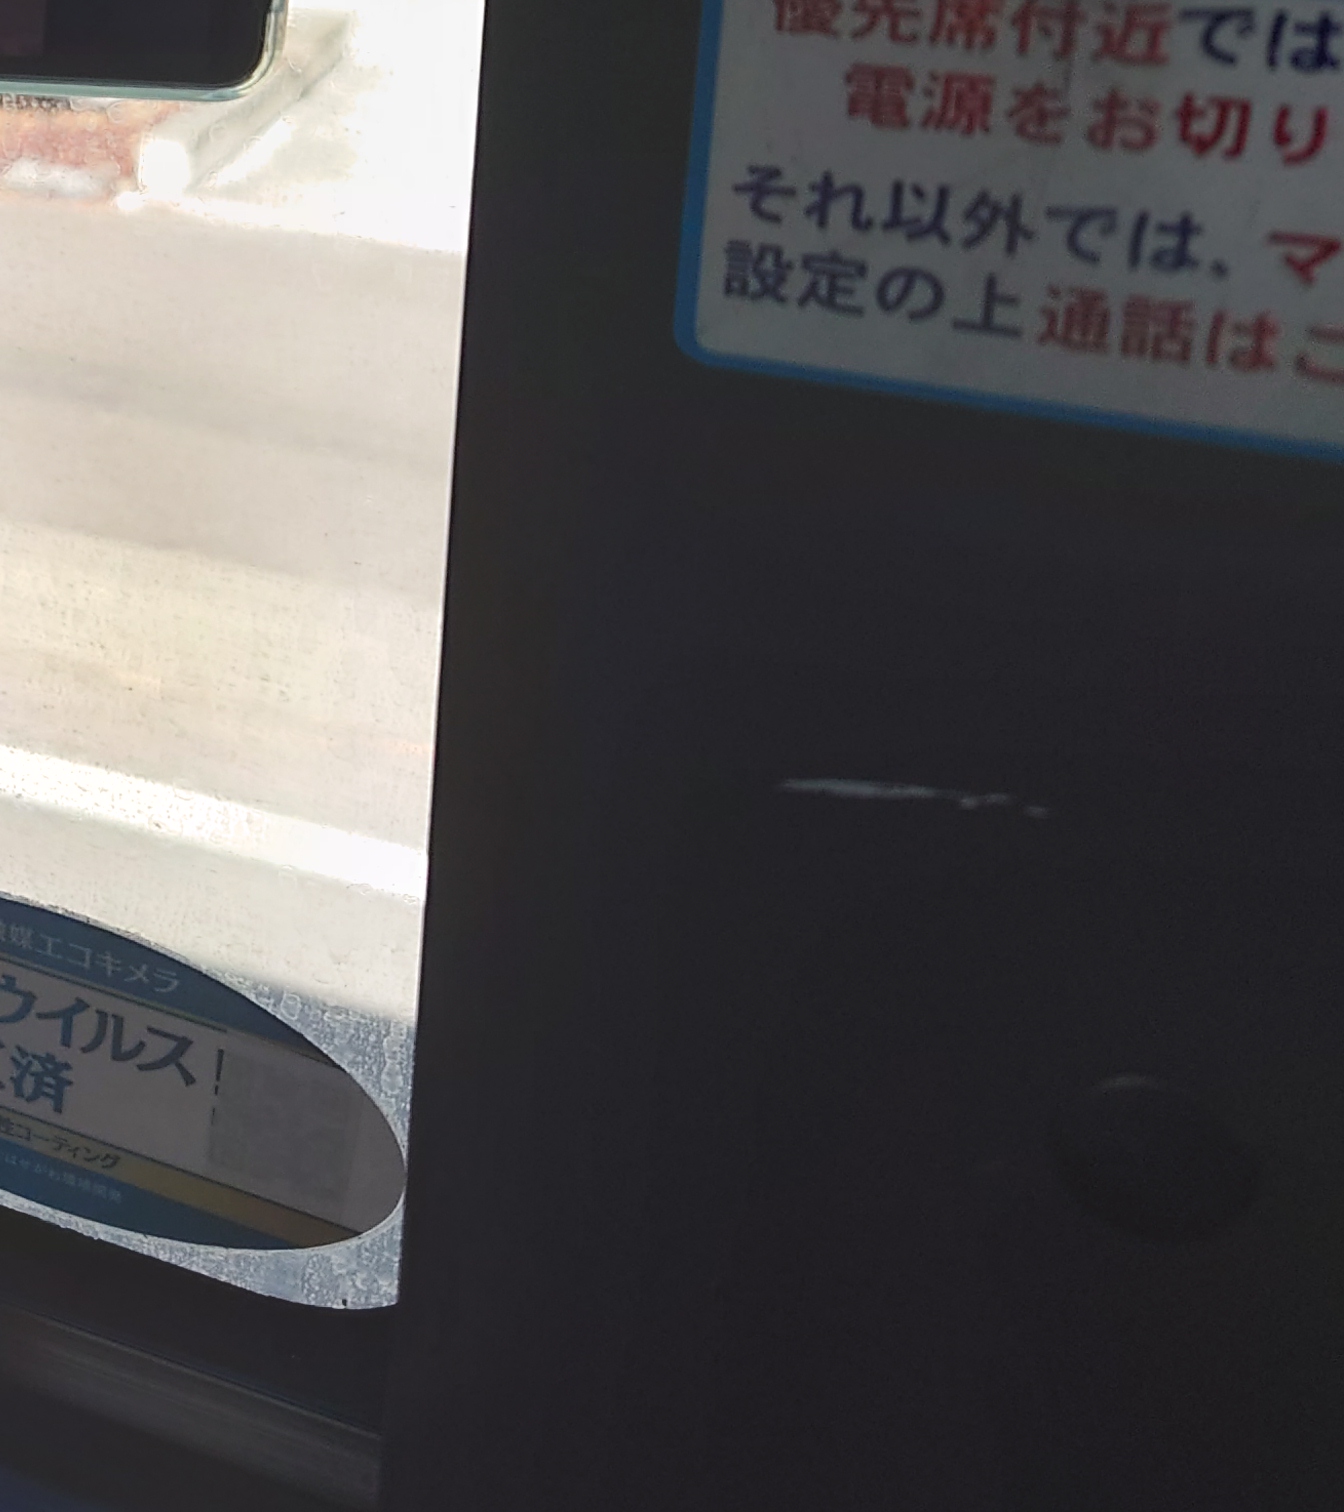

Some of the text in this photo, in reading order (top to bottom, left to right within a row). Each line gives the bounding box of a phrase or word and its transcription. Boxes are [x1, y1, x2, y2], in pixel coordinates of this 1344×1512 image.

[845, 61, 1330, 166] 電源をお切り
